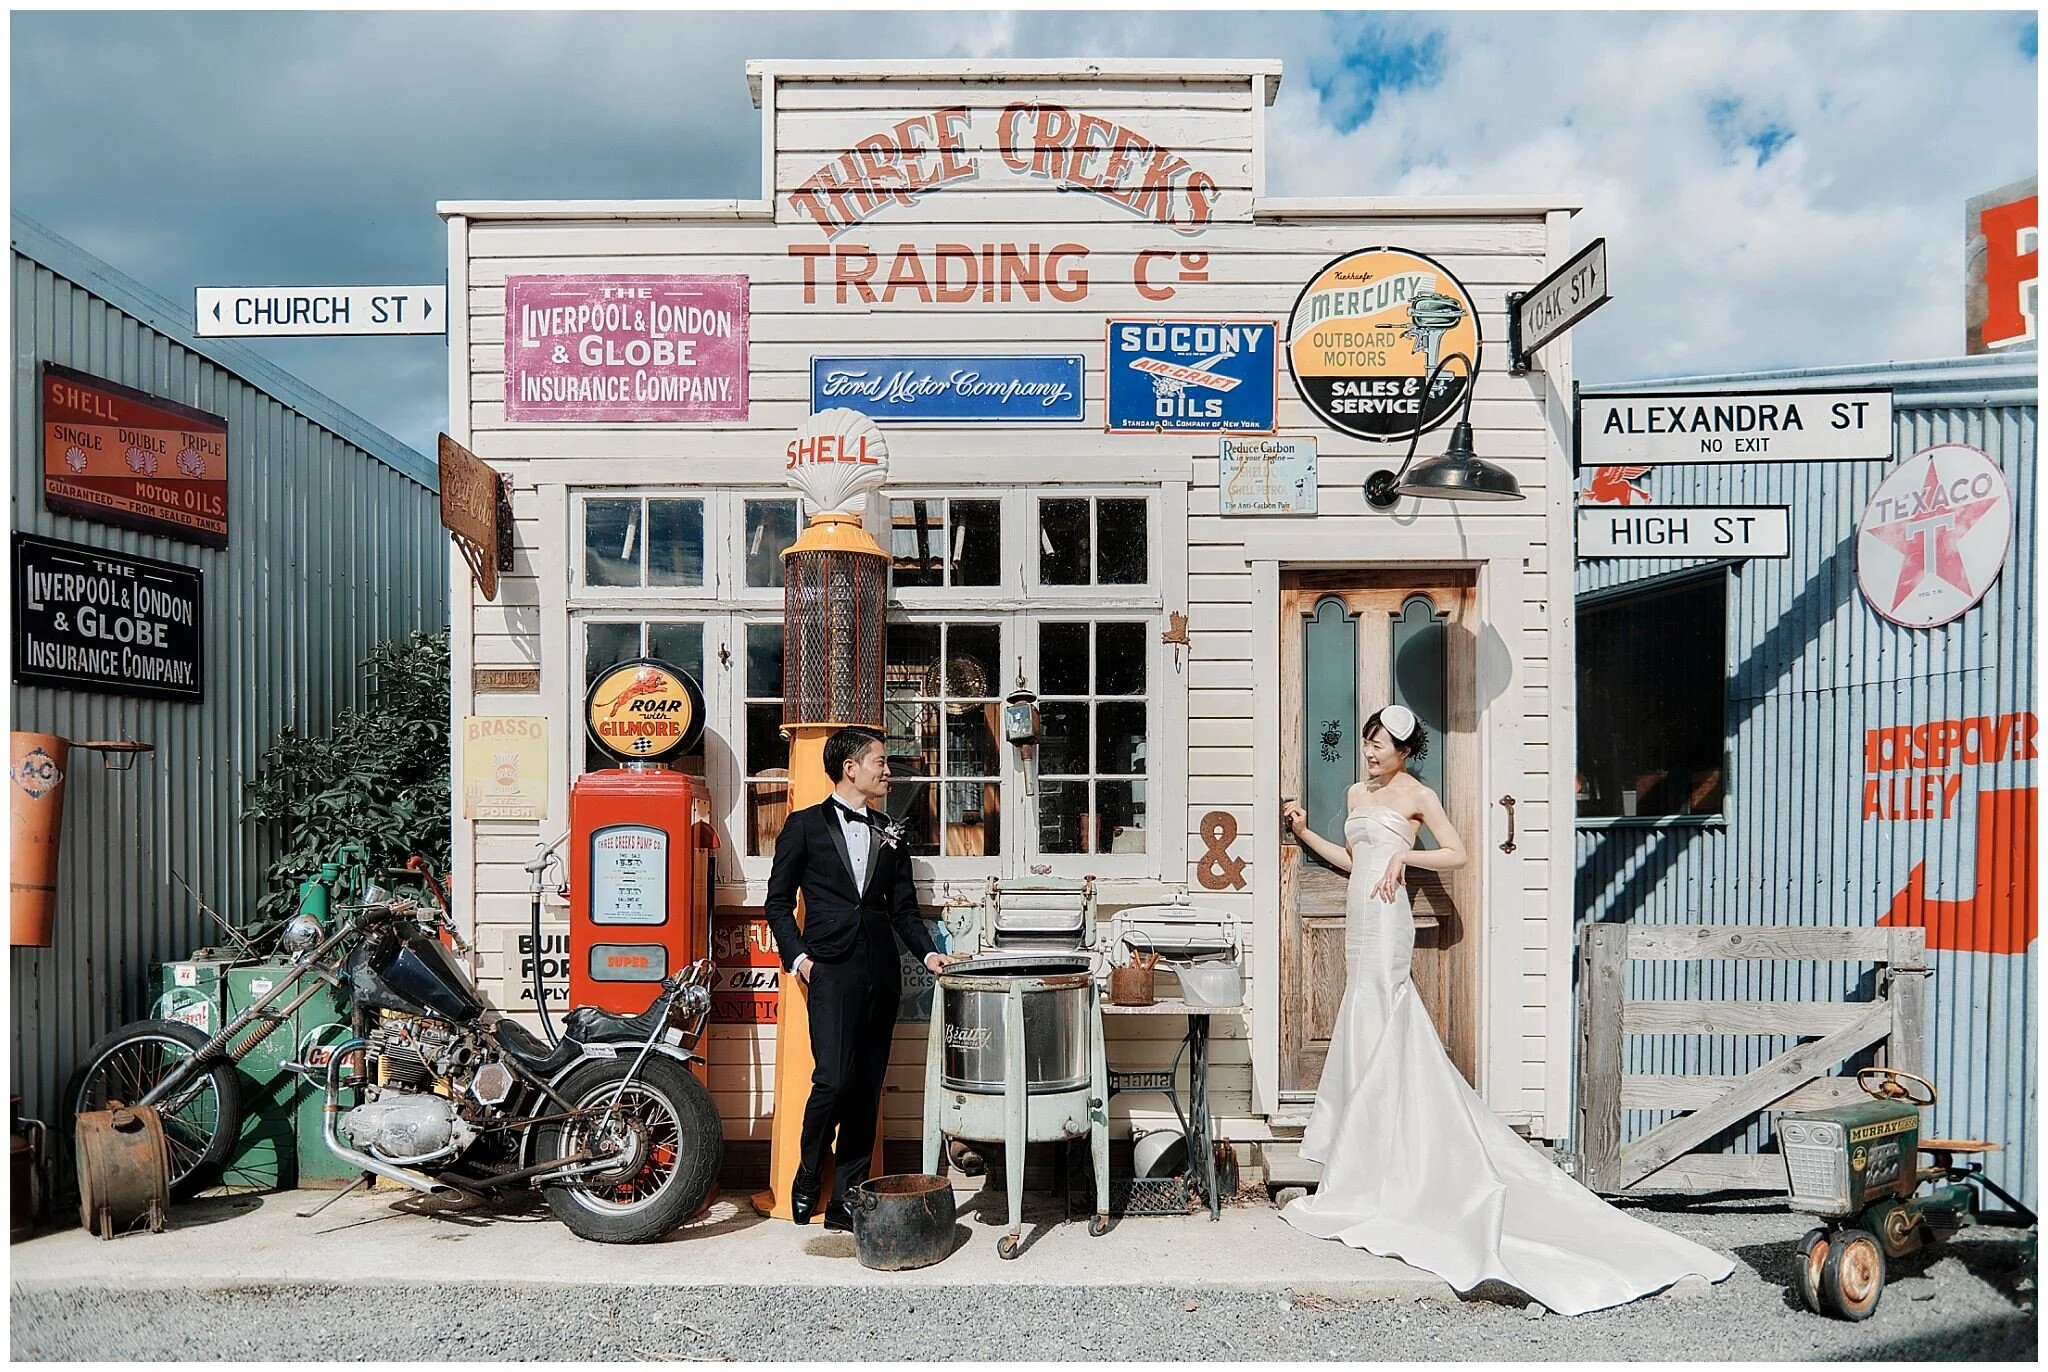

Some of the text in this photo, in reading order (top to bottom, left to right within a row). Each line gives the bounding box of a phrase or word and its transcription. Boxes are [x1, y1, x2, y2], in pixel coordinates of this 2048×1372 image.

[786, 100, 1222, 242] THREE CREEKS
[788, 242, 1091, 304] TRADING
[599, 287, 653, 299] THE
[1311, 276, 1423, 324] MERCURY
[1536, 268, 1588, 332] OAK ST
[235, 296, 408, 325] CHURCH ST
[521, 300, 732, 347] LIVERPOOL & LONDON
[551, 335, 697, 367] & GLOBE
[1120, 327, 1264, 353] SOCONY
[1312, 331, 1395, 349] OUTBOARD
[1323, 350, 1387, 368] MOTORS
[520, 369, 630, 402] INSURANCE
[822, 370, 1073, 407] Ford Motor Company
[1135, 359, 1238, 390] AIR-CRAFT
[1331, 377, 1420, 397] SALES &
[52, 383, 119, 422] SHELL
[1156, 398, 1223, 418] OILS
[1330, 398, 1420, 415] SERVICE
[1162, 419, 1175, 428] OIL
[1603, 401, 1870, 435] ALEXANDRA ST
[53, 425, 221, 457] SINGLE DOUBLE TRIPLE
[786, 434, 879, 470] SHELL
[1223, 440, 1295, 461] Reduce Carbon
[1700, 437, 1770, 453] NO EXIT
[49, 482, 113, 506] GUARANTEED
[129, 502, 156, 517] FROM
[159, 508, 192, 525] SEALED
[135, 481, 179, 506] MOTOR
[1875, 472, 1993, 524] TEXACO
[1610, 516, 1756, 545] HIGH ST
[92, 560, 136, 578] THE
[27, 564, 193, 628] LIVERPOOL & LONDON
[54, 605, 169, 649] & GLOBE
[27, 632, 119, 676] INSURANCE
[629, 699, 683, 713] ROAR
[639, 712, 672, 720] with
[468, 719, 543, 742] BRASSO
[599, 721, 681, 737] GILMORE
[1864, 711, 2039, 774] HORSEPOWER
[481, 806, 532, 817] POLISH
[1862, 773, 1963, 822] ALLEY
[1196, 810, 1247, 891] &
[606, 955, 649, 969] SUPER
[1852, 1120, 1898, 1140] MURRAY
[1856, 1149, 1864, 1158] 2
